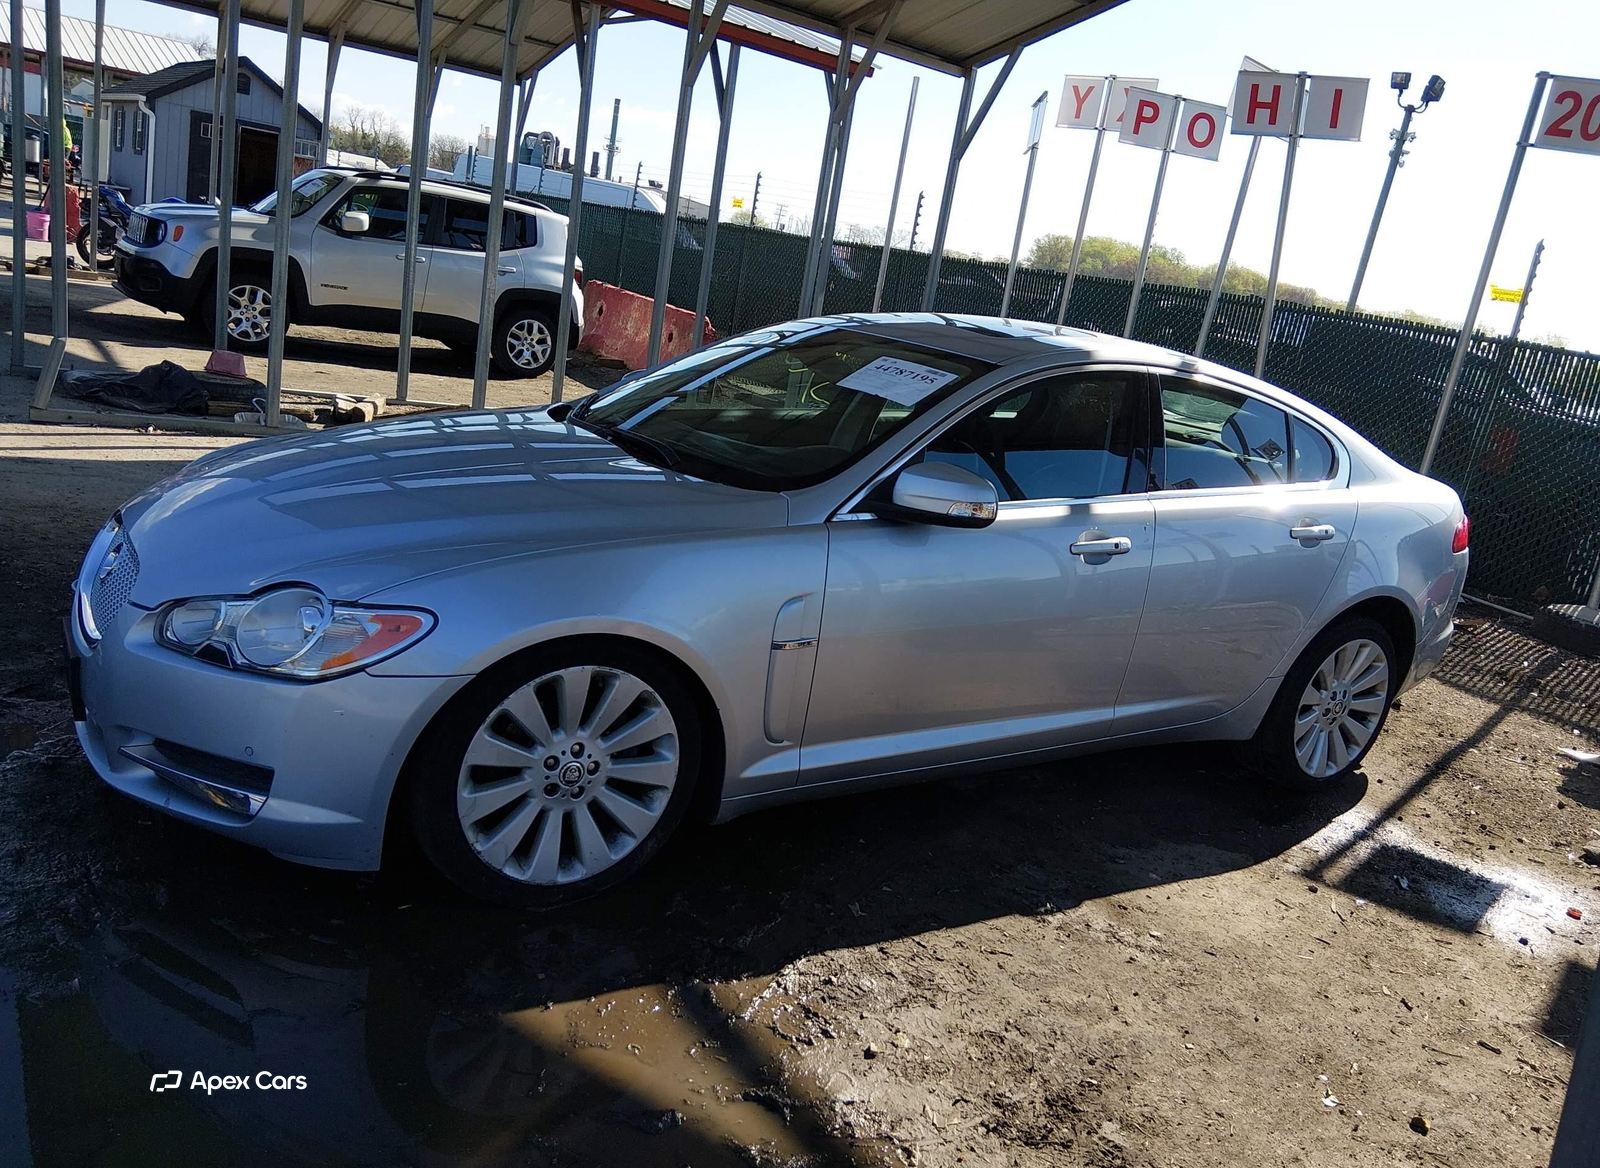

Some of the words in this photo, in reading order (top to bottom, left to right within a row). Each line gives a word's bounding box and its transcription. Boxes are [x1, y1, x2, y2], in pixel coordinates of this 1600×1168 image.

[1072, 85, 1096, 120] Y
[1132, 99, 1160, 135] P
[1246, 83, 1281, 125] H
[1329, 88, 1343, 129] I
[874, 364, 938, 384] 44787195
